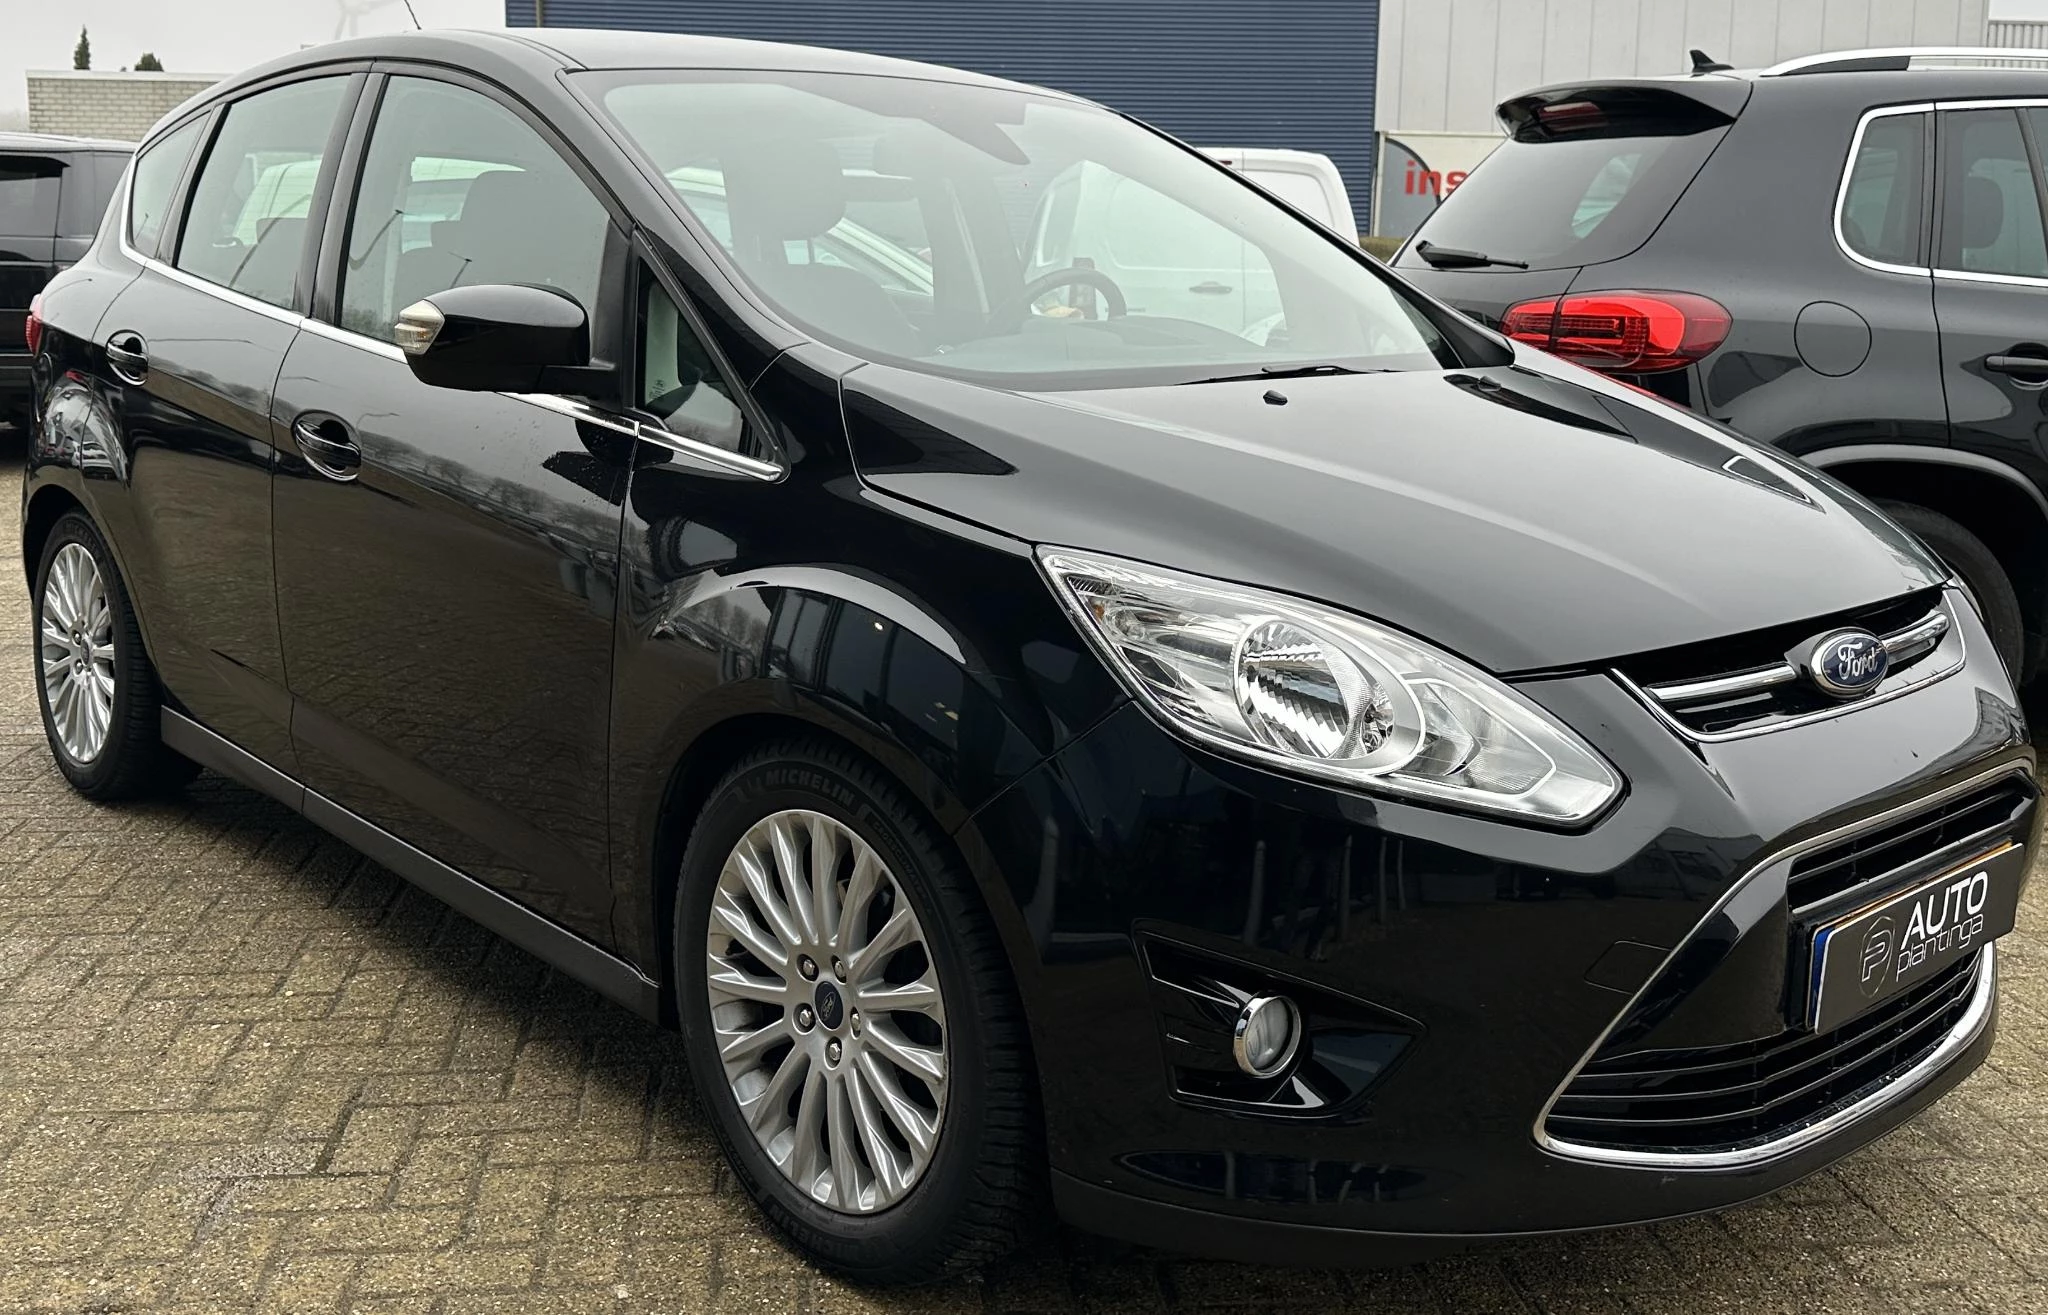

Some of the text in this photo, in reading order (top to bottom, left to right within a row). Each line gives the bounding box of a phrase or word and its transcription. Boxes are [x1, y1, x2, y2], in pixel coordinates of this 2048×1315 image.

[1837, 641, 1878, 680] Ford
[765, 768, 856, 806] MICHELIN
[1899, 870, 1989, 951] AUTO
[1895, 913, 1984, 982] plantinga
